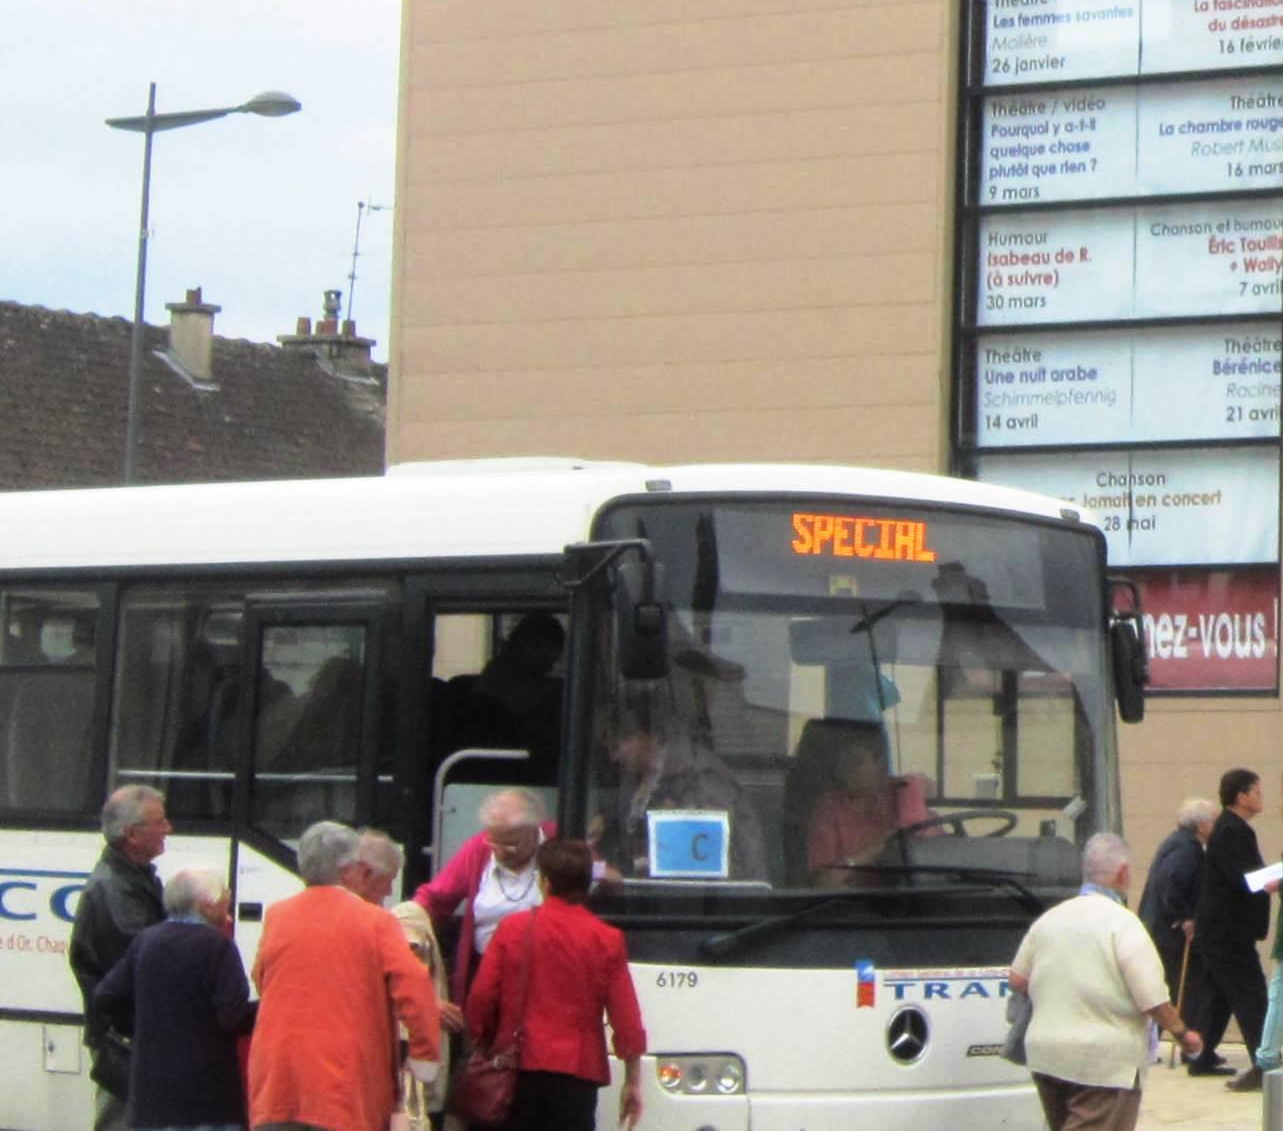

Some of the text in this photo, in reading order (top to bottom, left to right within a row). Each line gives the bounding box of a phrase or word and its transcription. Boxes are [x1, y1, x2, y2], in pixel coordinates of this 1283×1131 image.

[1194, 0, 1209, 12] La
[993, 15, 1015, 29] Les
[1017, 11, 1071, 27] femmes
[1208, 19, 1226, 32] du
[1218, 39, 1235, 54] 16
[992, 54, 1066, 75] 26 janvier
[991, 122, 1049, 139] Pourquoi
[1159, 122, 1175, 136] La
[1178, 118, 1242, 135] chambre
[990, 139, 1090, 160] quelque chose
[1191, 139, 1245, 156] Robert
[1031, 164, 1056, 179] que
[1060, 159, 1085, 174] rien
[1226, 161, 1243, 177] 16
[988, 185, 1040, 199] 9 mars
[1150, 221, 1212, 237] Chanson
[1216, 219, 1230, 233] et
[988, 231, 1048, 247] Humour
[1208, 235, 1235, 255] Éric
[988, 249, 1050, 267] Isabeau
[1055, 248, 1075, 263] de
[1007, 269, 1060, 288] suivre)
[1239, 281, 1248, 297] 7
[986, 294, 1046, 310] 30 mars
[1223, 336, 1282, 354] Théâtre
[985, 347, 1042, 365] Théâtre
[985, 365, 1098, 385] Une nuit arabe
[1213, 358, 1282, 376] Bérénice
[1226, 382, 1280, 398] Racine
[985, 413, 1038, 429] 14 avril
[1226, 406, 1243, 423] 21
[1096, 471, 1167, 488] Chanson
[1136, 492, 1156, 506] en
[1162, 489, 1222, 507] concert
[1104, 516, 1156, 532] 28 mai
[792, 513, 935, 563] SPECIAL
[691, 833, 710, 862] C
[656, 972, 698, 988] 6179
